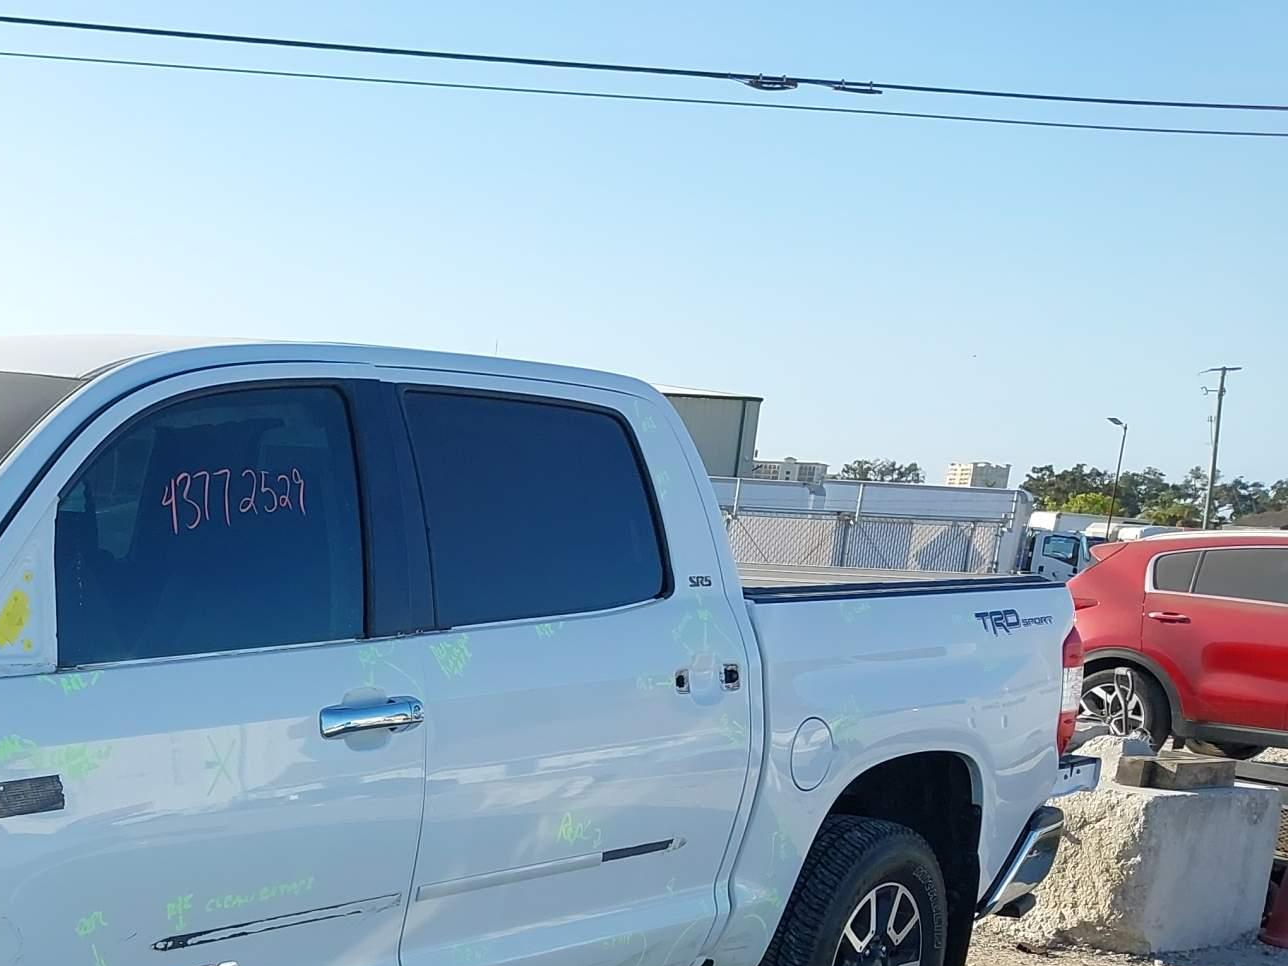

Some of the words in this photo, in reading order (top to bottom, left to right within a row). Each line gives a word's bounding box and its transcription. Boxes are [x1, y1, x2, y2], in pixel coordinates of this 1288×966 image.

[162, 468, 306, 535] 43772529
[688, 576, 712, 588] SR5
[974, 609, 1021, 637] TRD
[1021, 615, 1053, 627] SPORT
